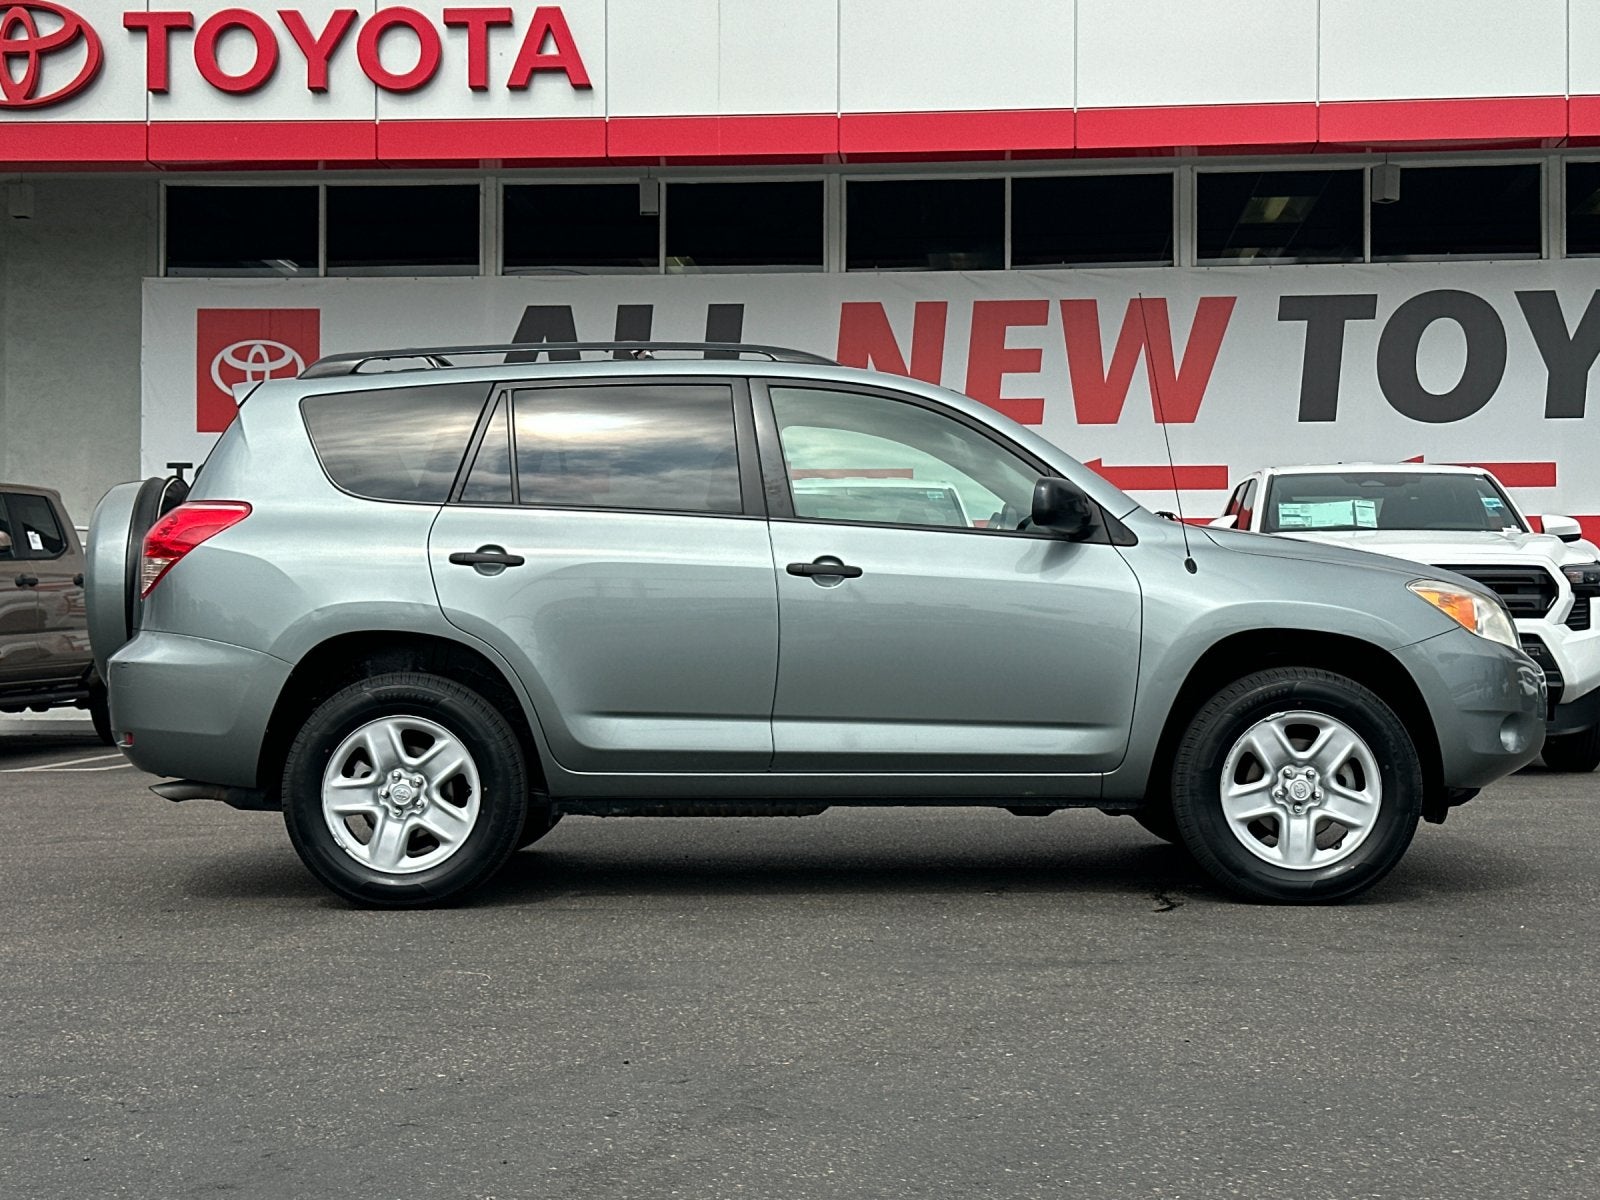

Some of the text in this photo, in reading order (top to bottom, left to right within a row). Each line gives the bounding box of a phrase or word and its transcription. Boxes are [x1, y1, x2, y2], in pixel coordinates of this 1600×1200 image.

[123, 6, 593, 94] TOYOTA
[835, 296, 1237, 424] NEW
[1278, 288, 1600, 423] TOY
